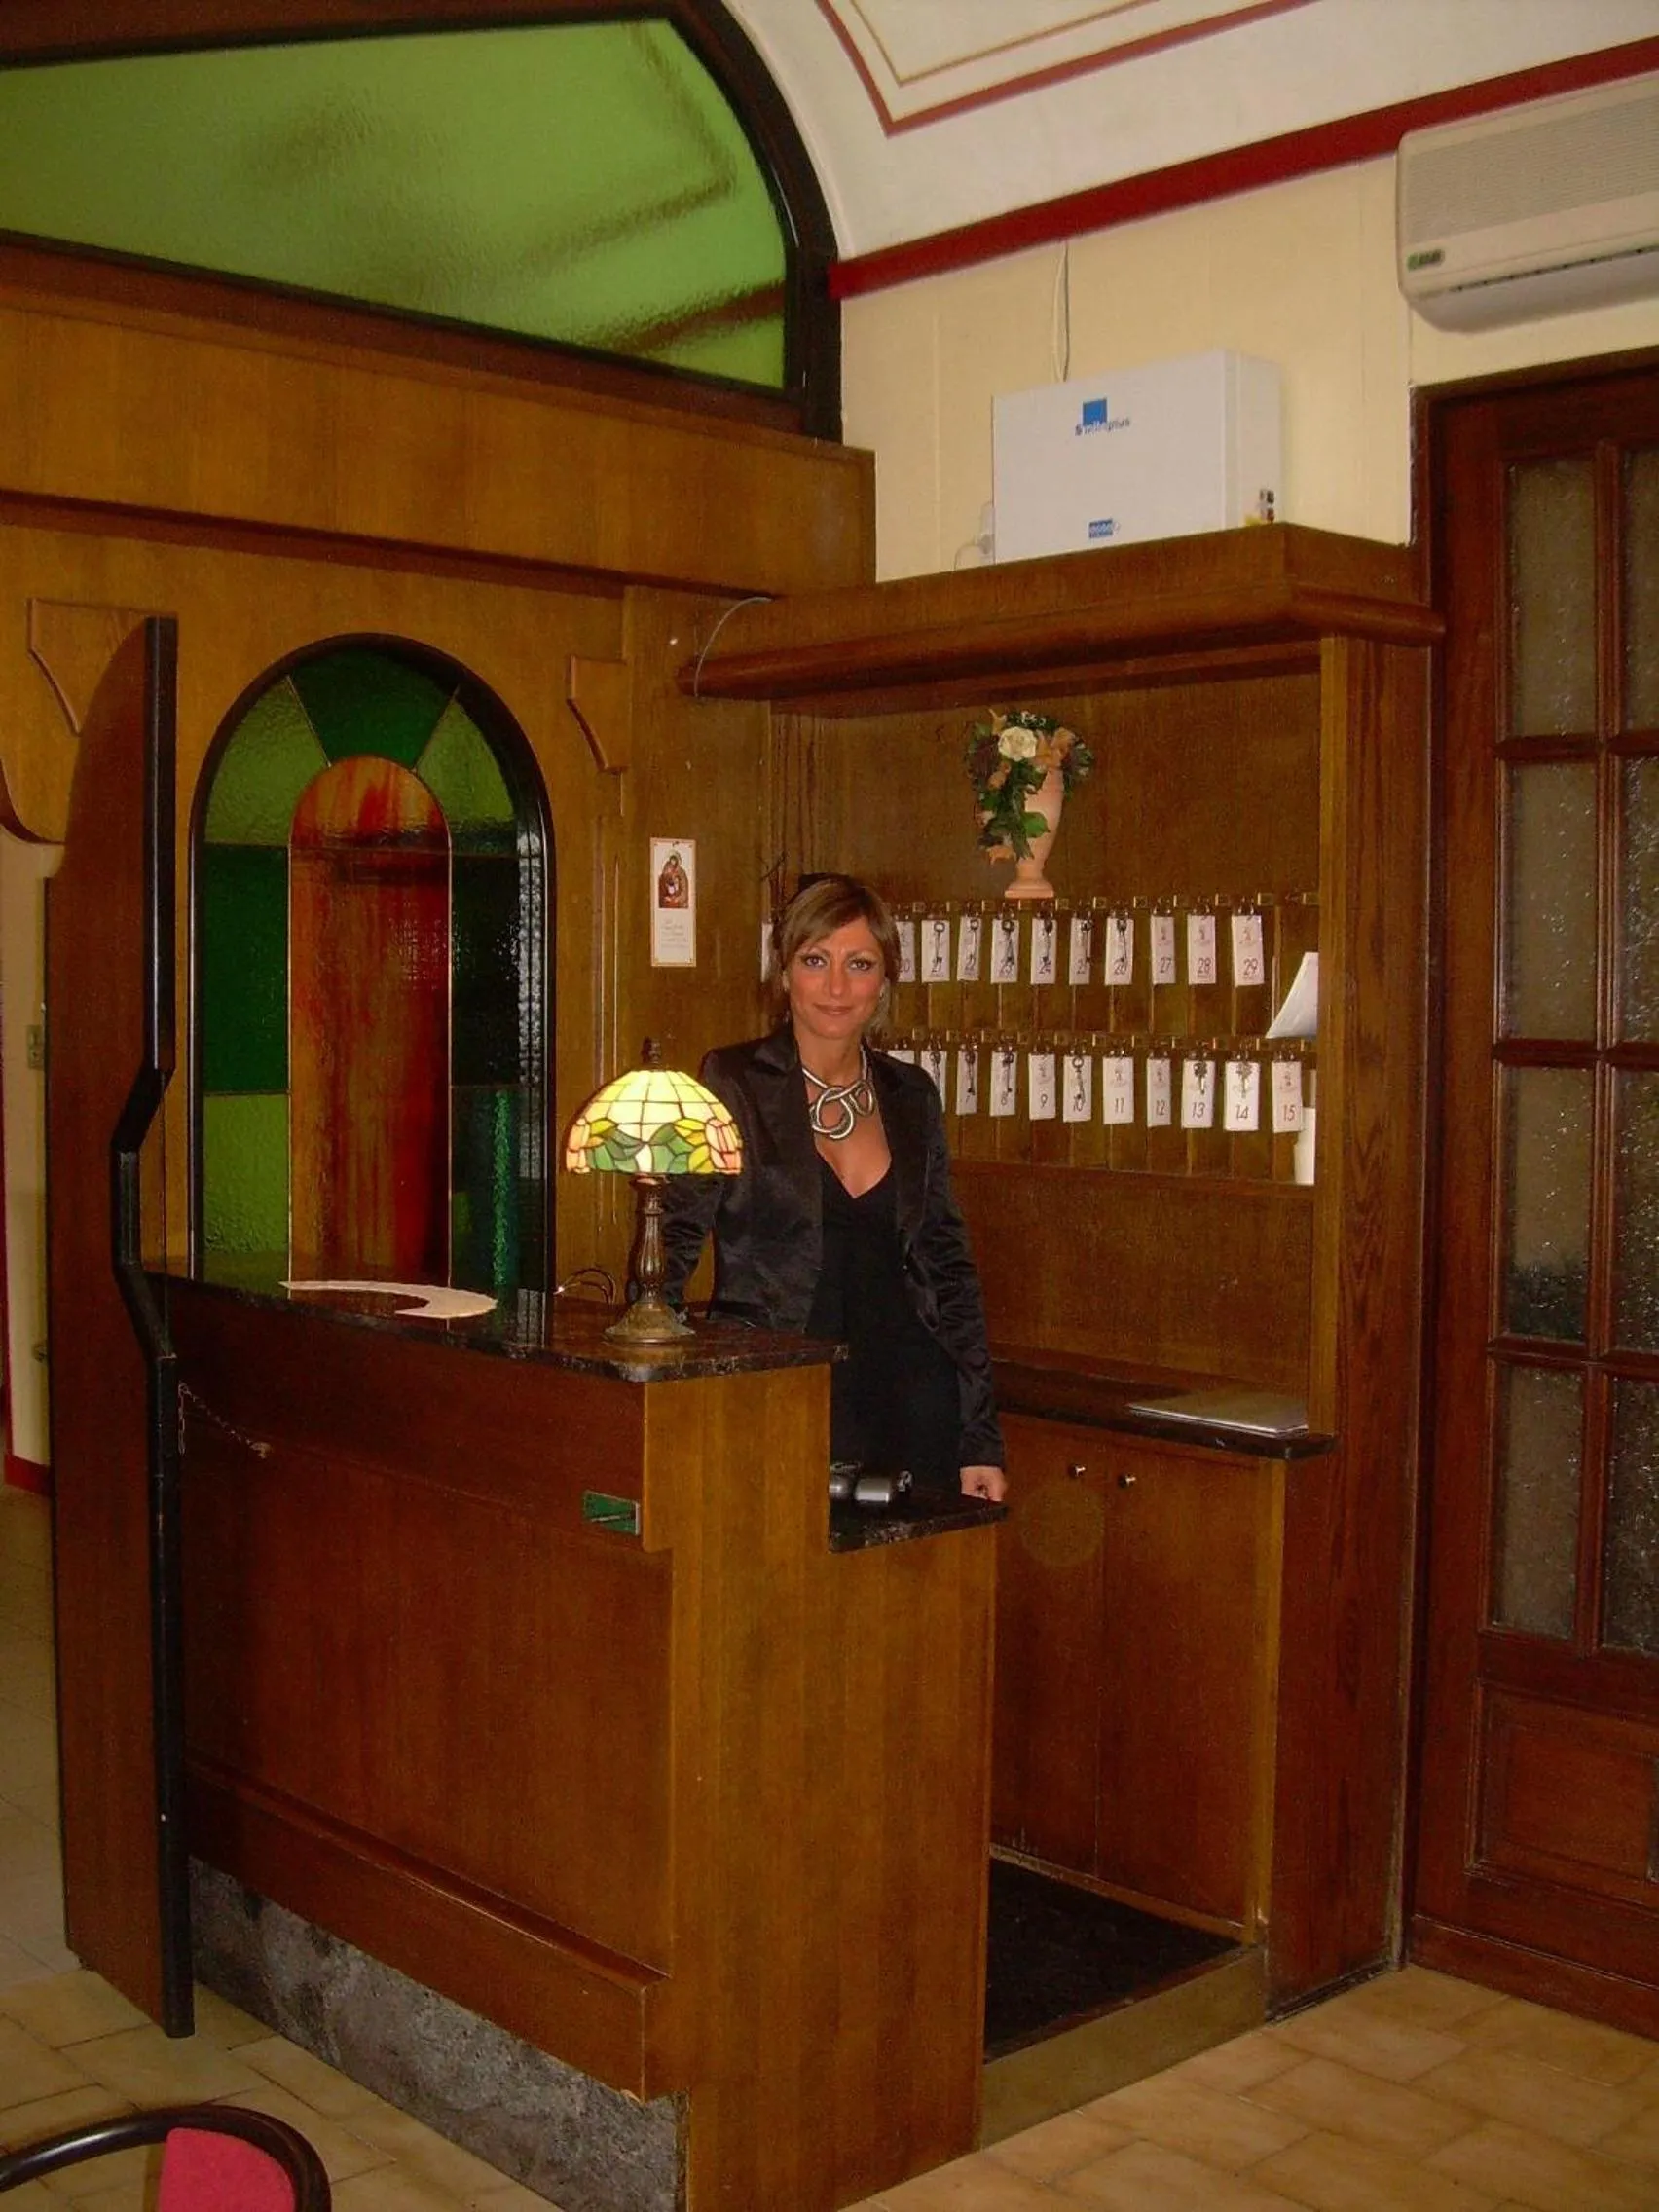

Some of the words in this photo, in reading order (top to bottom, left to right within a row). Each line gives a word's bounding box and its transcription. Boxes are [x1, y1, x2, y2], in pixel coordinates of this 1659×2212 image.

[1159, 957, 1171, 973] 27
[1198, 958, 1211, 974] 28
[1243, 958, 1259, 974] 29
[1040, 1094, 1049, 1109] 9
[1114, 1098, 1124, 1113] 11
[1156, 1100, 1168, 1116] 12
[1192, 1101, 1205, 1118] 13
[1235, 1104, 1250, 1120] 14
[1283, 1104, 1296, 1121] 15
